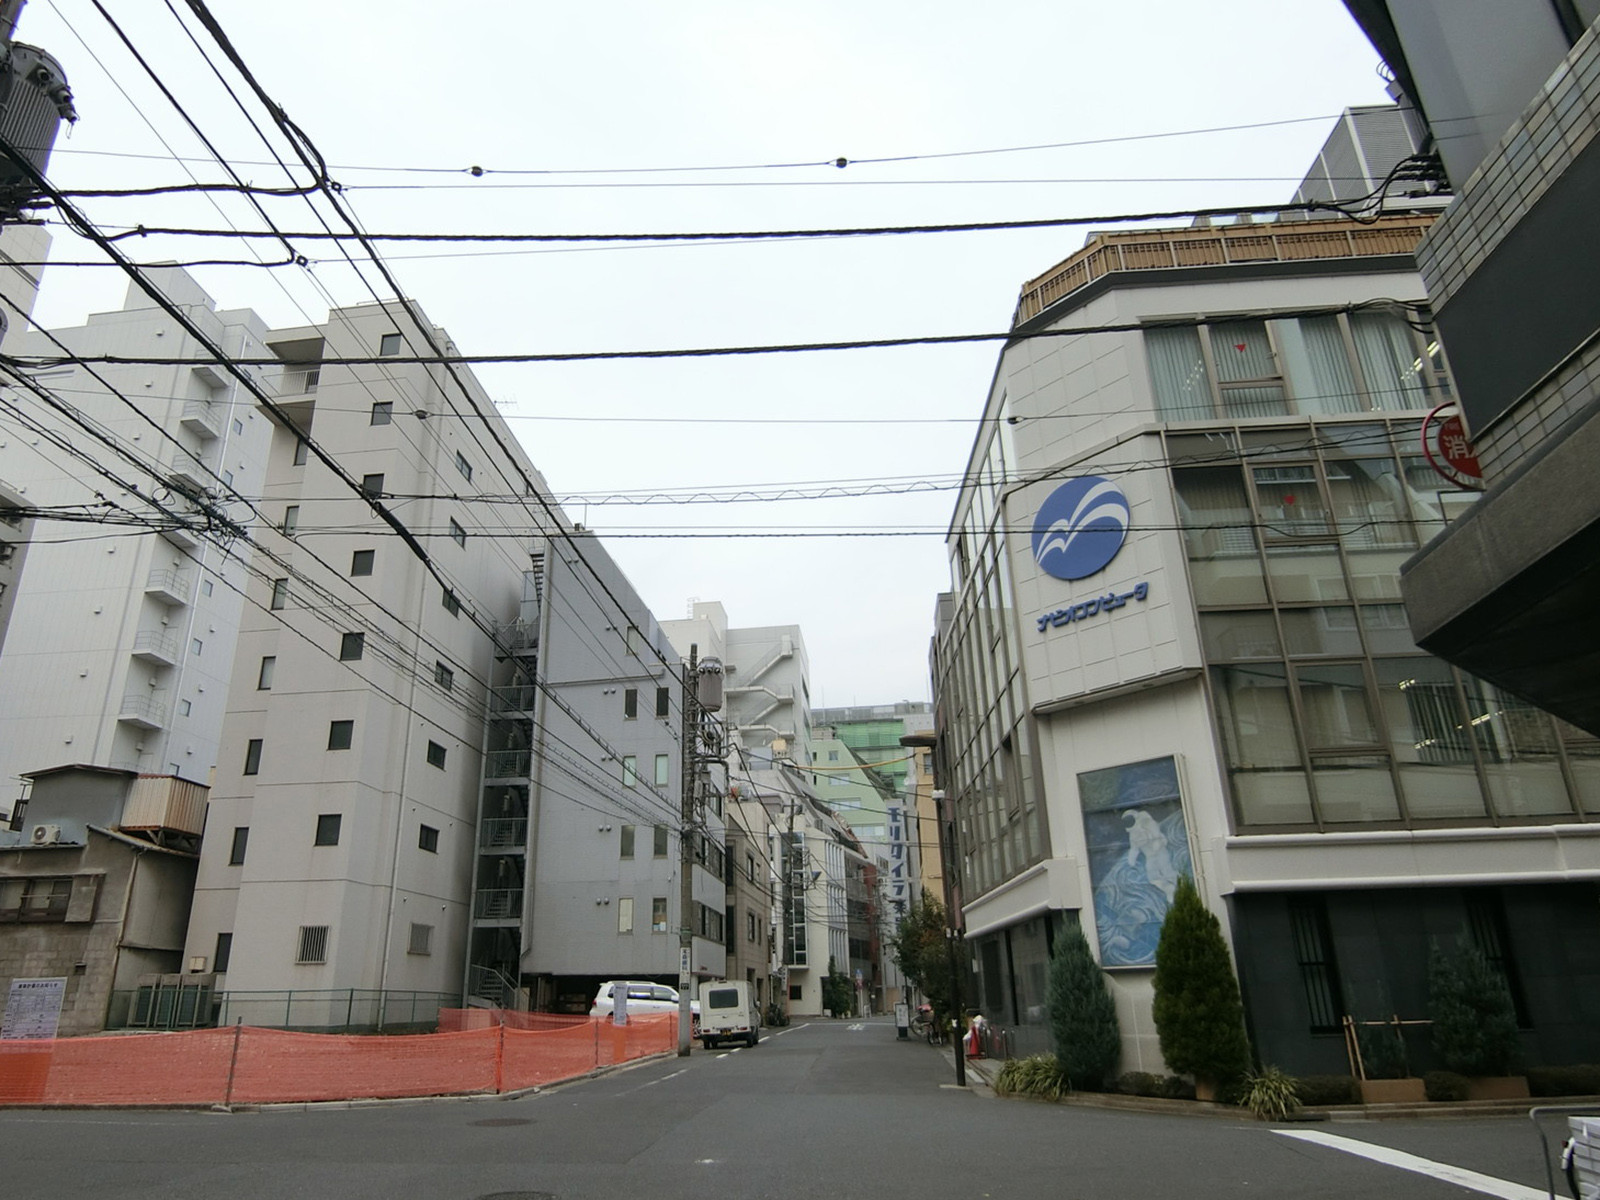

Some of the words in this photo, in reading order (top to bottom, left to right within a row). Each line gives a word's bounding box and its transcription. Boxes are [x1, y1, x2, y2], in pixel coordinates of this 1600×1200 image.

[1037, 582, 1148, 632] ナビオコンピュータ
